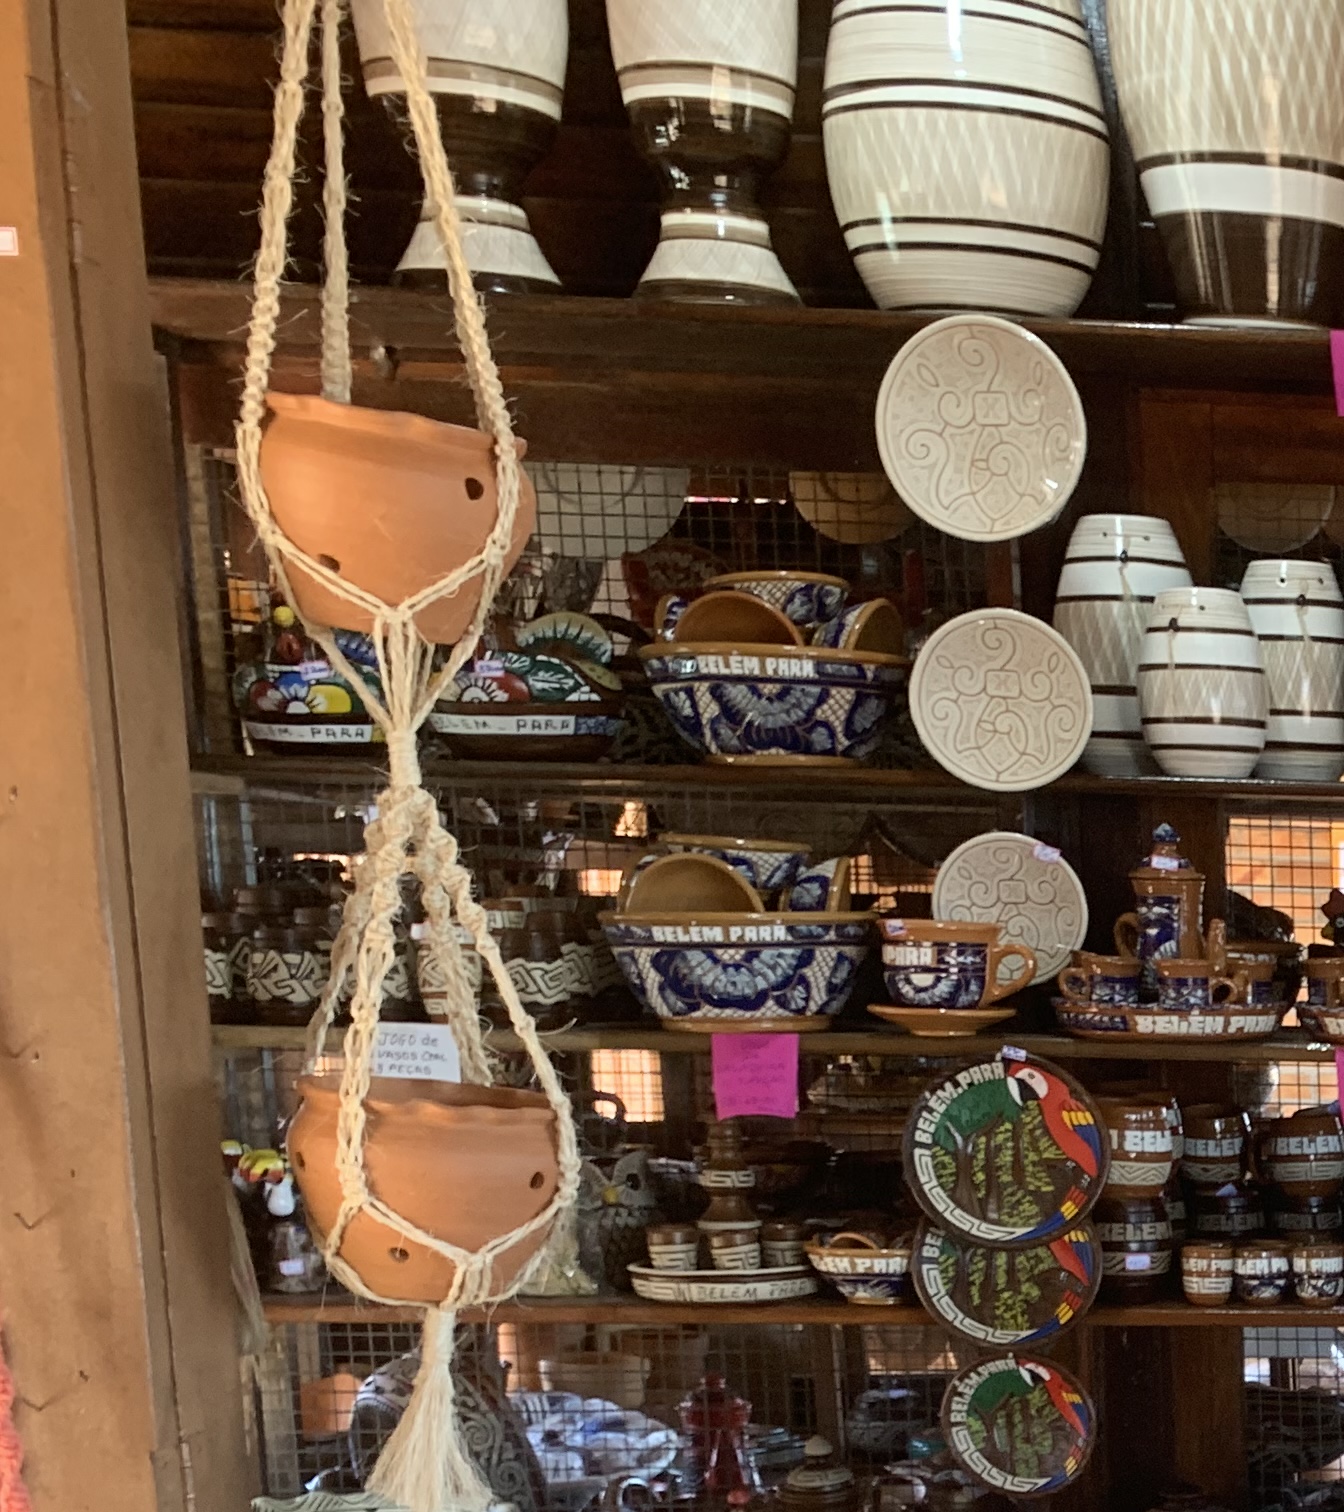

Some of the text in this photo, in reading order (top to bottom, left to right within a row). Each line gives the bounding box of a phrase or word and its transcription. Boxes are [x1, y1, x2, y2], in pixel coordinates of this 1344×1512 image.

[651, 920, 725, 943] BELÉM
[1135, 1010, 1225, 1034] BELÉM
[378, 1032, 417, 1047] JOGO
